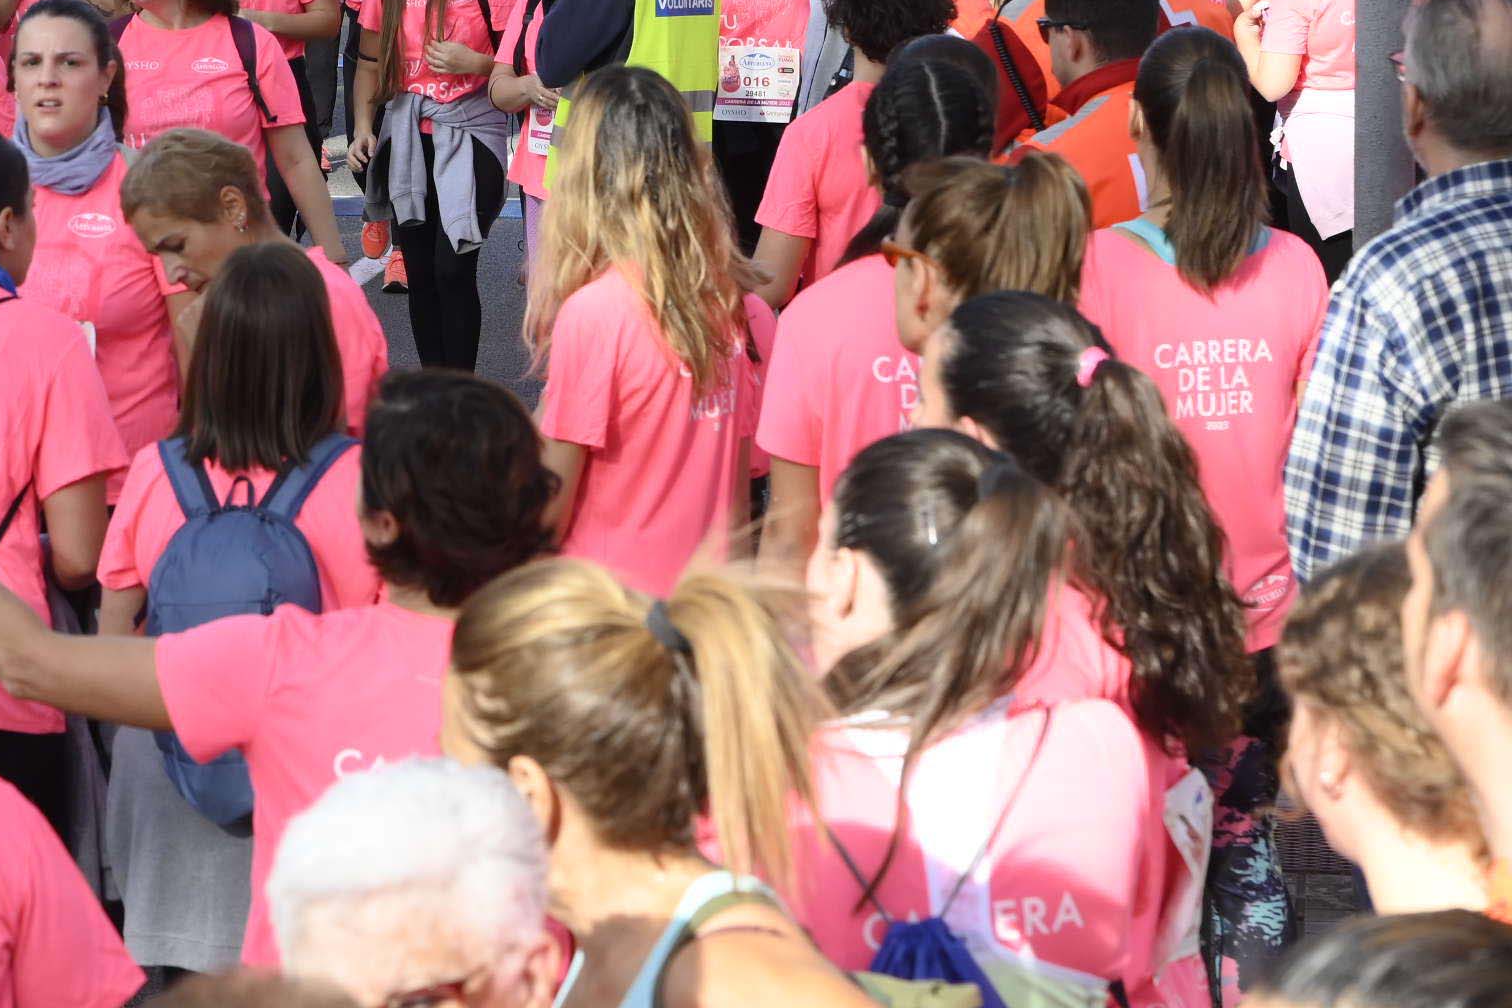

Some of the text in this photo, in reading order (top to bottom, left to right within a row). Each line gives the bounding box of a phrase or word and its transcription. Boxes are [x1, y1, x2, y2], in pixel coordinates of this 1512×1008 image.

[743, 76, 770, 87] 016
[1153, 339, 1273, 367] CARRERA
[872, 355, 925, 382] CA
[1178, 364, 1250, 392] DE LA
[1175, 390, 1254, 419] MUJER
